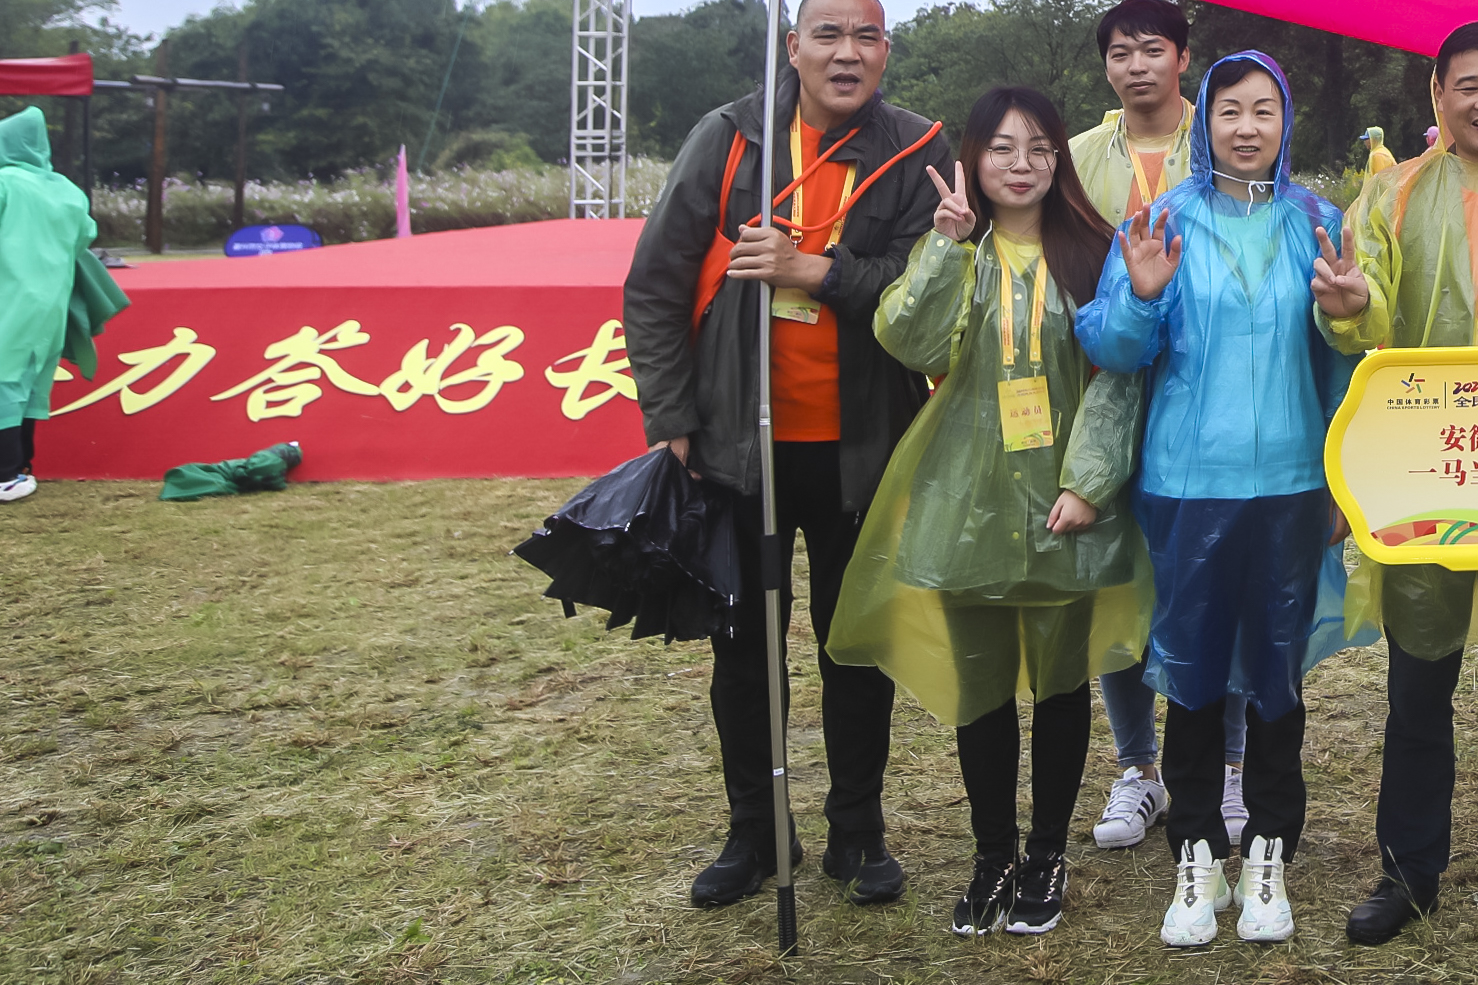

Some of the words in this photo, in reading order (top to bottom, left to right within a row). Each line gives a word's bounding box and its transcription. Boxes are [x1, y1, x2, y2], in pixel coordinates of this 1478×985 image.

[49, 319, 638, 421] 力答好长
[1387, 398, 1440, 406] 中国体育彩票
